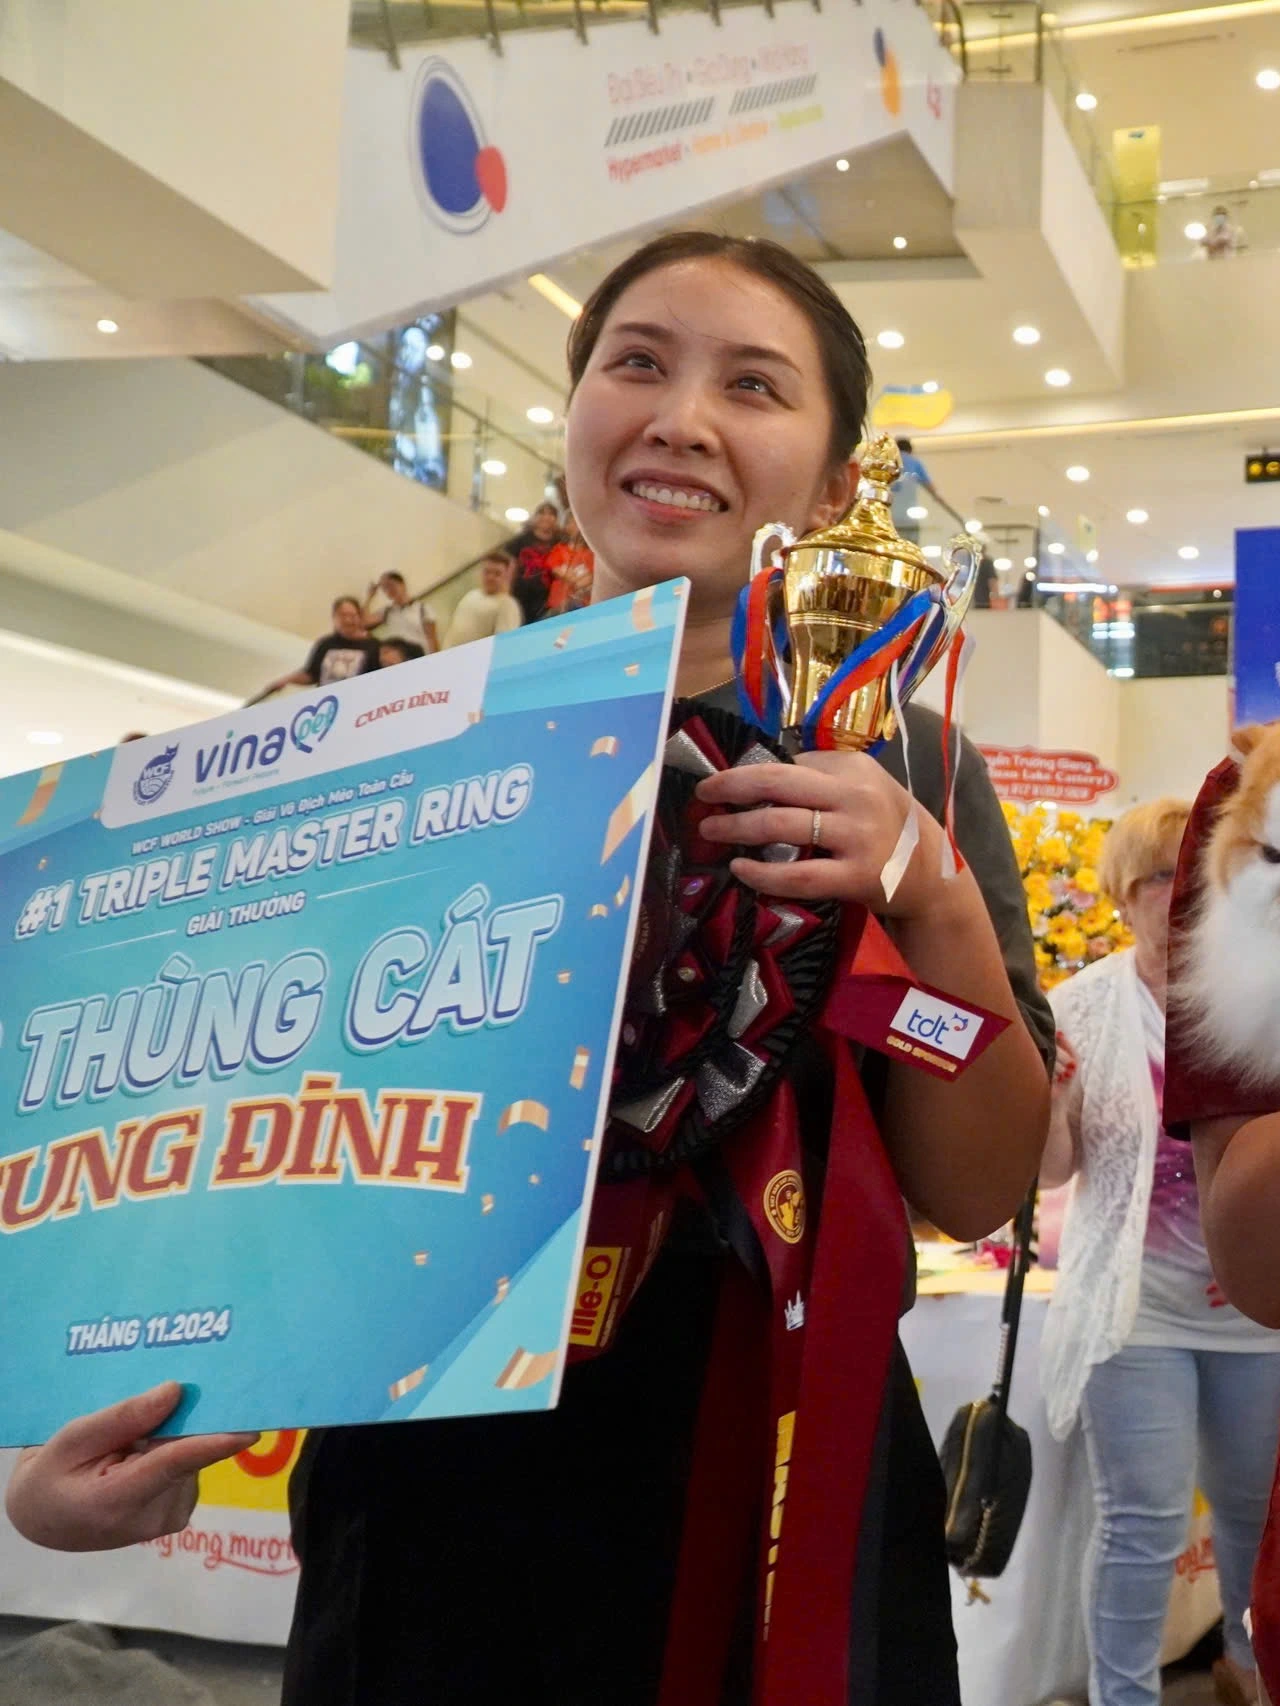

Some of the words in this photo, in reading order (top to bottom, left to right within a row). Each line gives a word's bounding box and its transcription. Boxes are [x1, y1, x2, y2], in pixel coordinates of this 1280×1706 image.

[142, 764, 171, 780] WCF
[195, 727, 287, 784] vina
[355, 698, 405, 729] CUNG
[17, 886, 71, 937] #1
[81, 851, 217, 920] TRIPLE
[223, 801, 403, 885] MASTER
[414, 766, 531, 838] RING
[131, 838, 158, 856] WCF
[160, 826, 201, 849] WORLD
[204, 815, 243, 837] SHOW
[186, 904, 224, 938] GIẢI
[20, 952, 327, 1107] THÙNG
[346, 885, 563, 1050] CÁT
[0, 1108, 203, 1228] UNG
[210, 1074, 480, 1191] ĐÌNH
[68, 1316, 142, 1352] THÁNG
[145, 1309, 231, 1345] 11.2024
